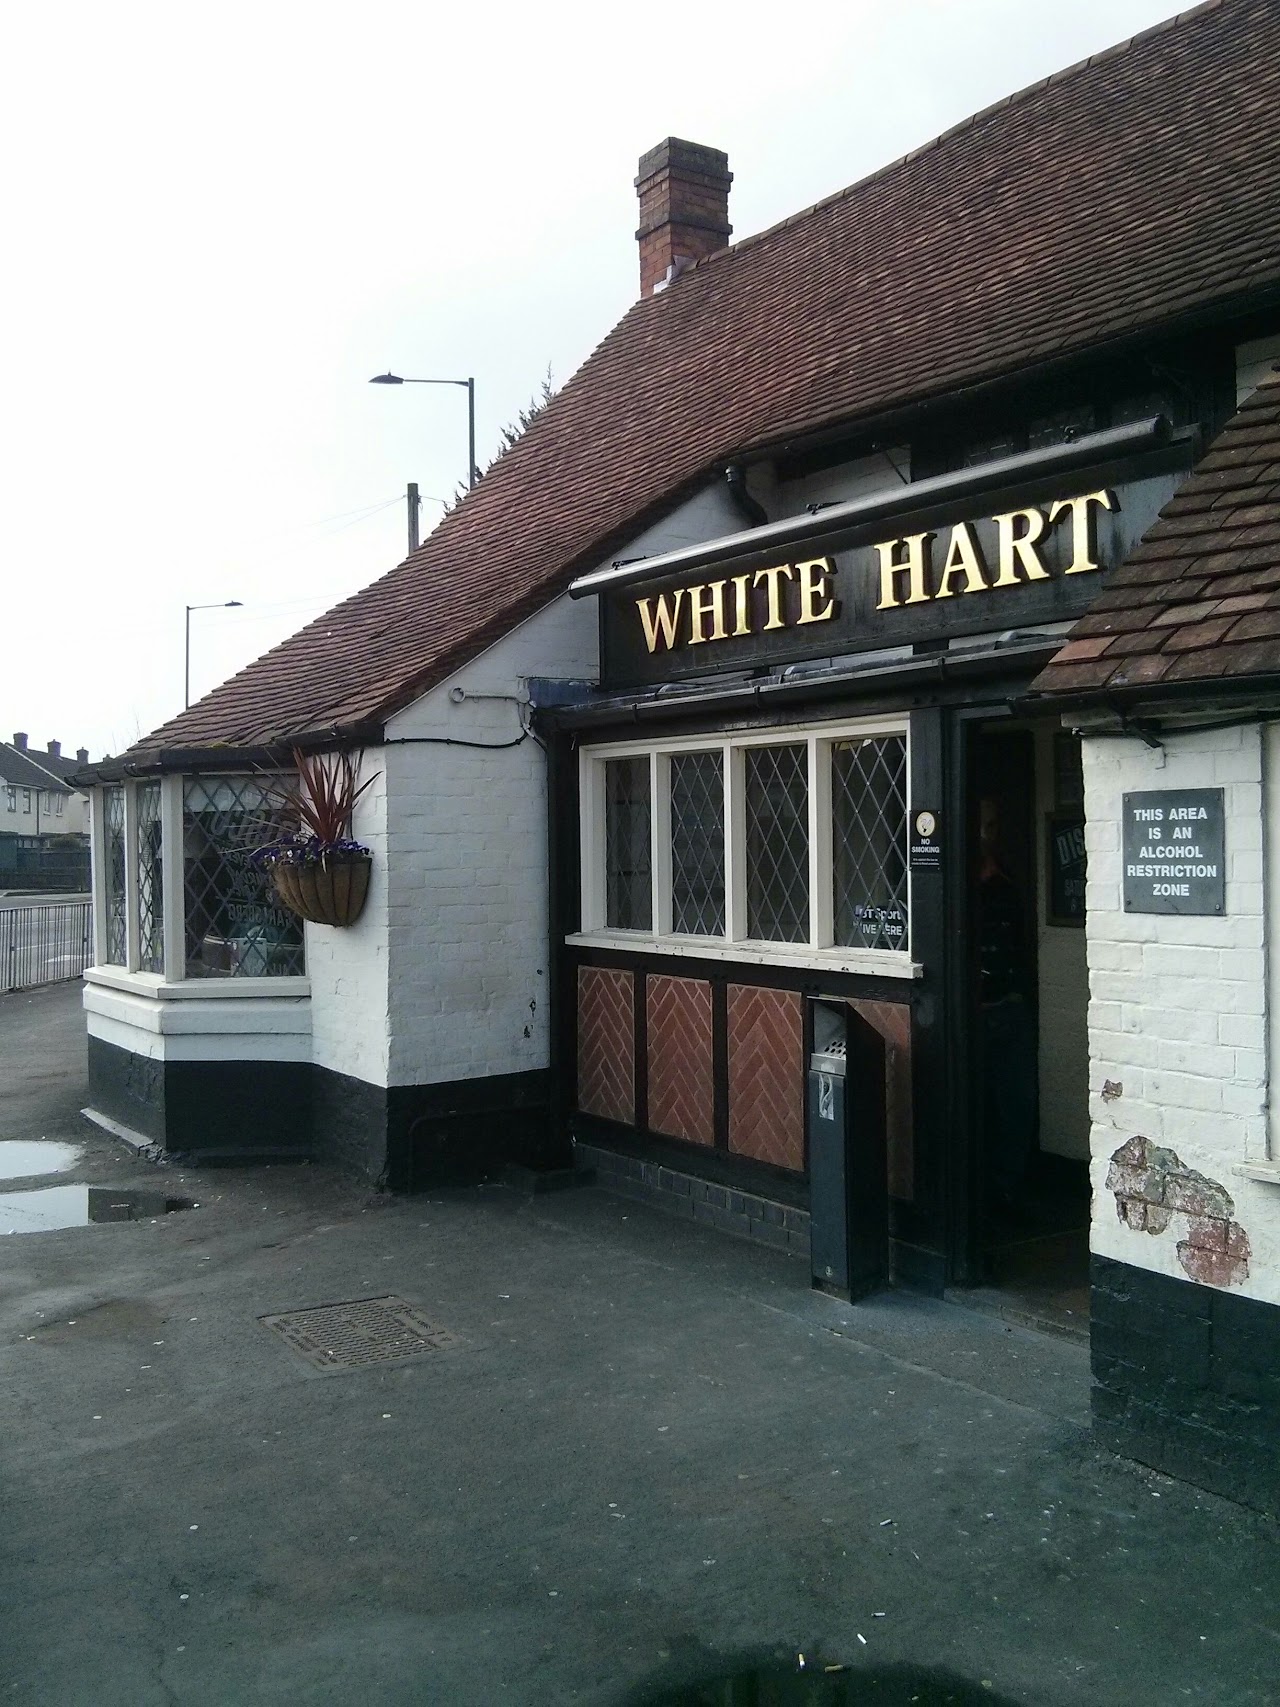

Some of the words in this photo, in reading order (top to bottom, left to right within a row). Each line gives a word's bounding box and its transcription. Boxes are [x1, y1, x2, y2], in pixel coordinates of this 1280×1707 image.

[635, 555, 840, 654] WHITE
[874, 489, 1120, 611] HART
[1133, 808, 1163, 821] THIS
[1169, 807, 1208, 820] AREA
[1148, 827, 1162, 840] IS
[1173, 826, 1192, 839] AN
[1139, 846, 1204, 858] ALCOHOL
[1127, 864, 1217, 878] RESTRICTION
[1152, 884, 1190, 896] ZONE
[861, 924, 877, 934] IVE
